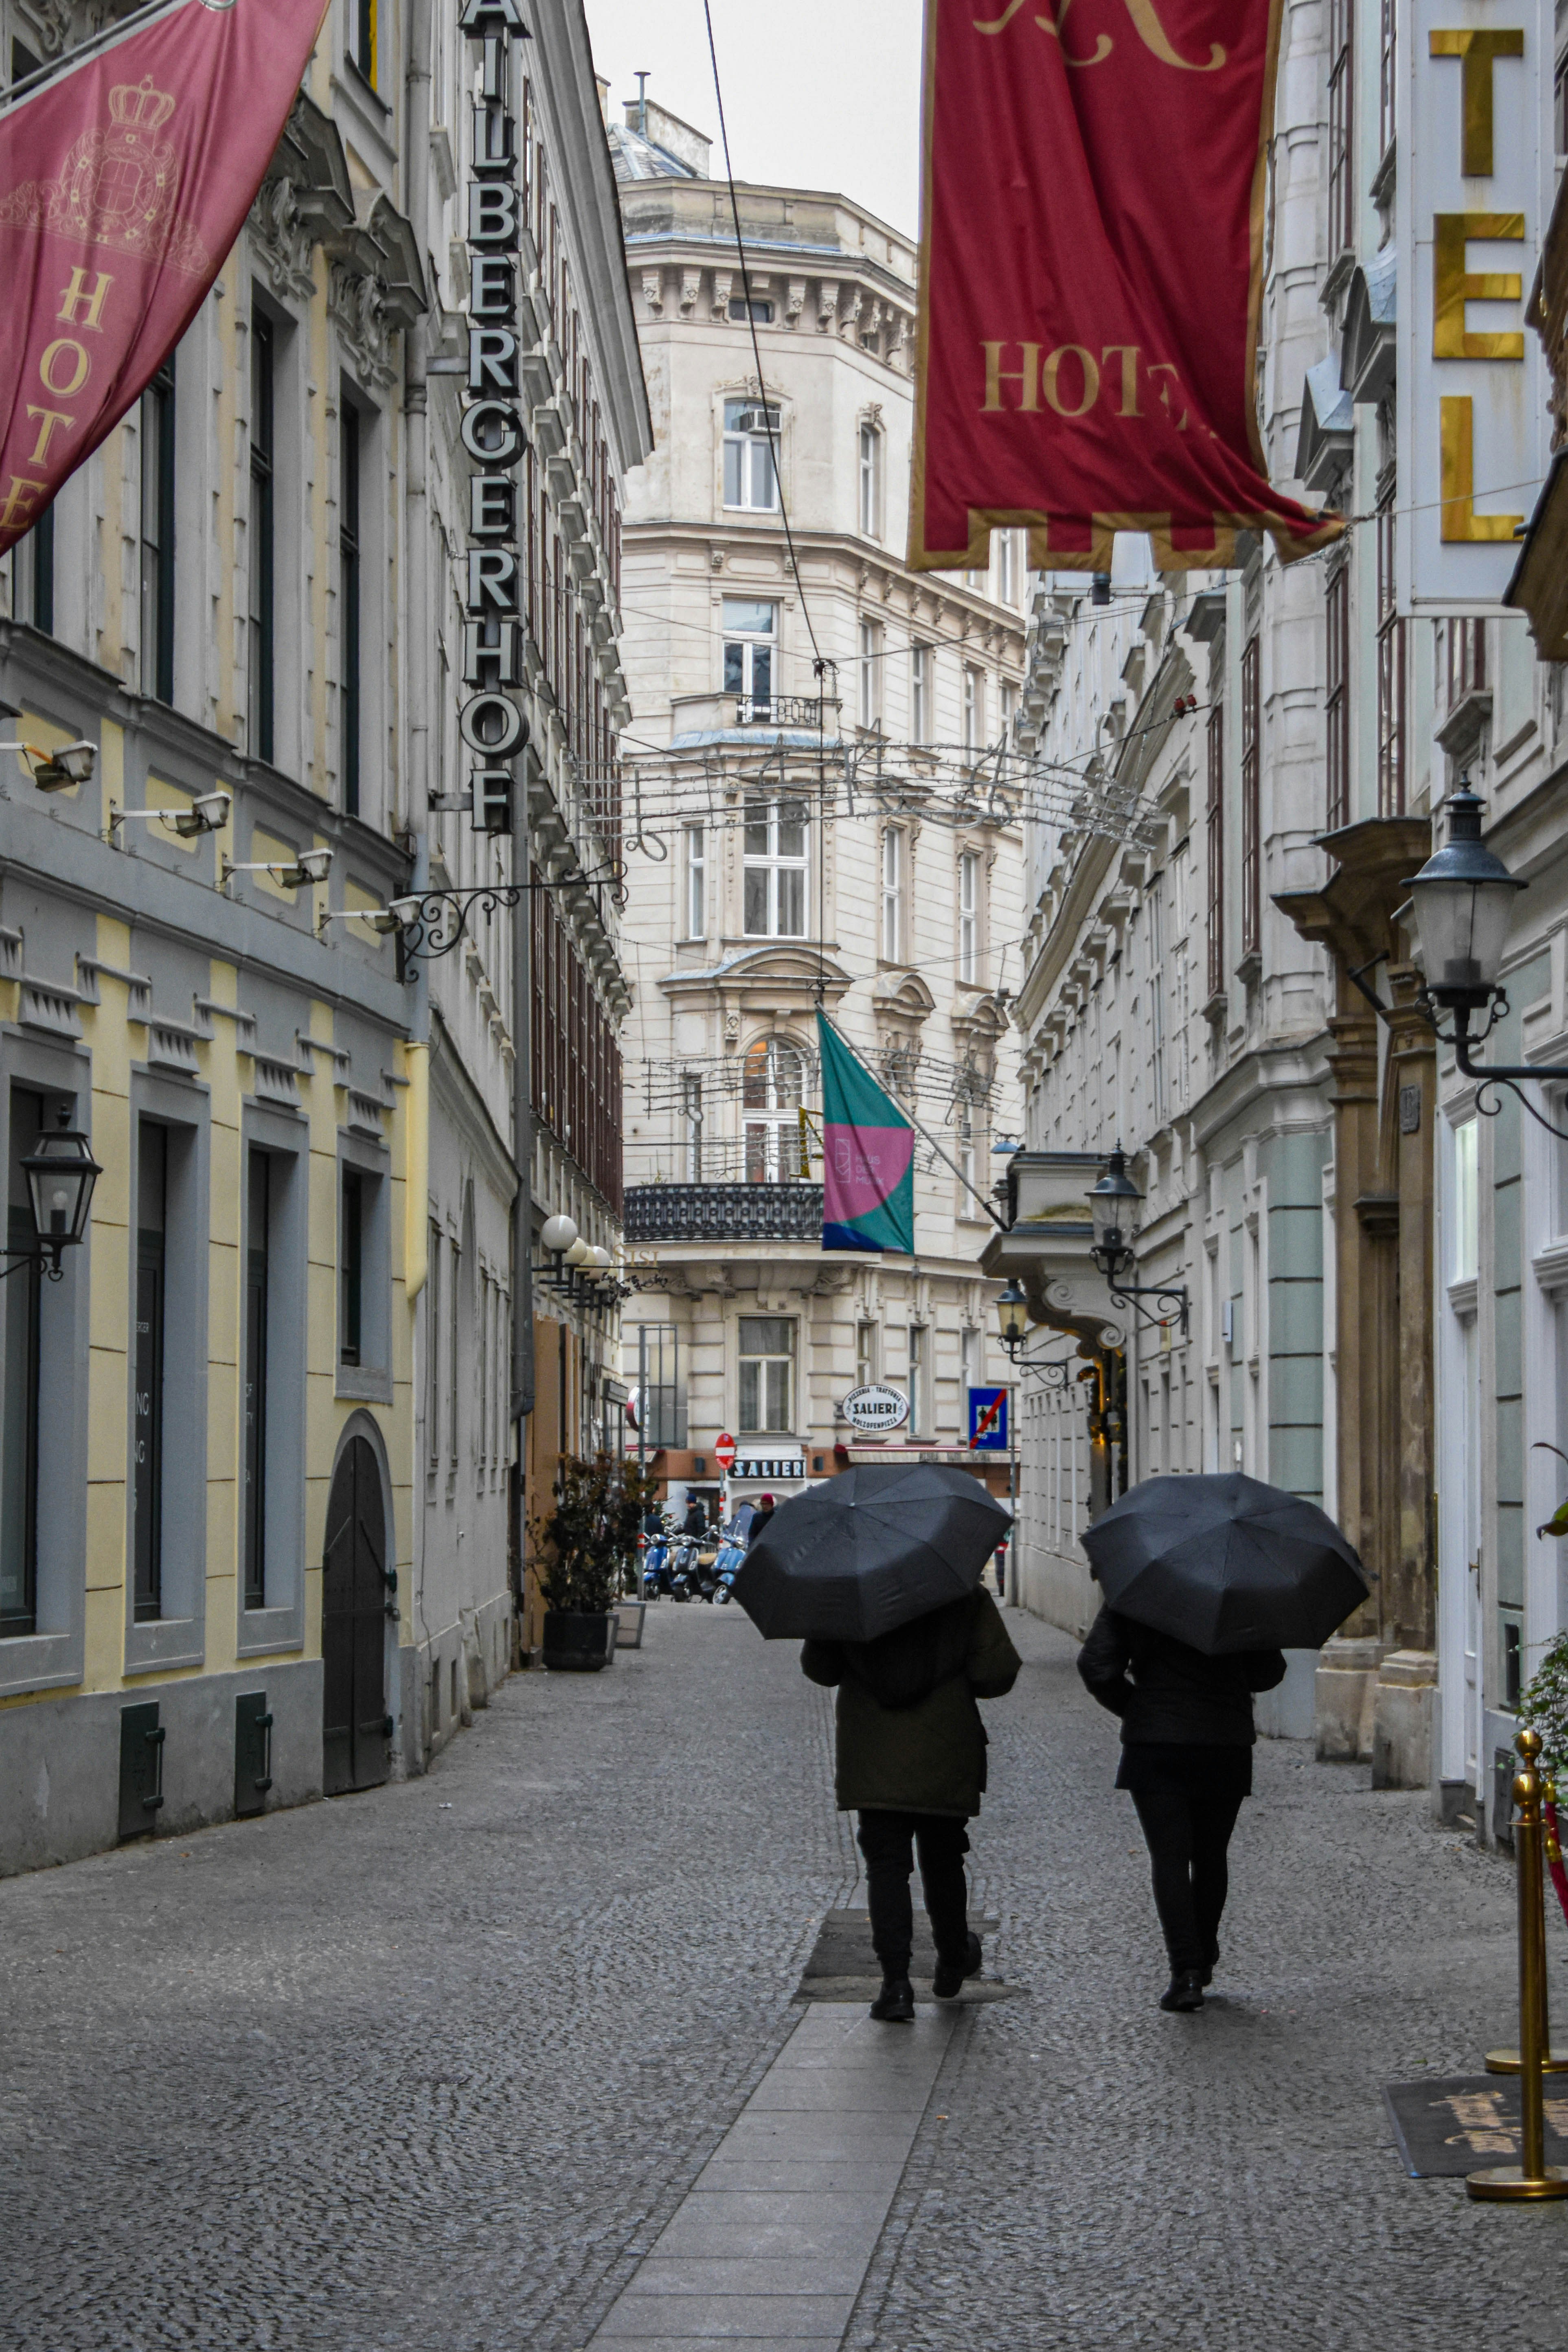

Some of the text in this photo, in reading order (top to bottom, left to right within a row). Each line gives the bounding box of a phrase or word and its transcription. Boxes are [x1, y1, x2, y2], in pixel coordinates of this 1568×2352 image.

[1429, 29, 1525, 542] TEL
[613, 1243, 659, 1267] SISI
[848, 1387, 901, 1403] PIZZERIA TRATTORIA
[853, 1403, 897, 1414] SALIERI
